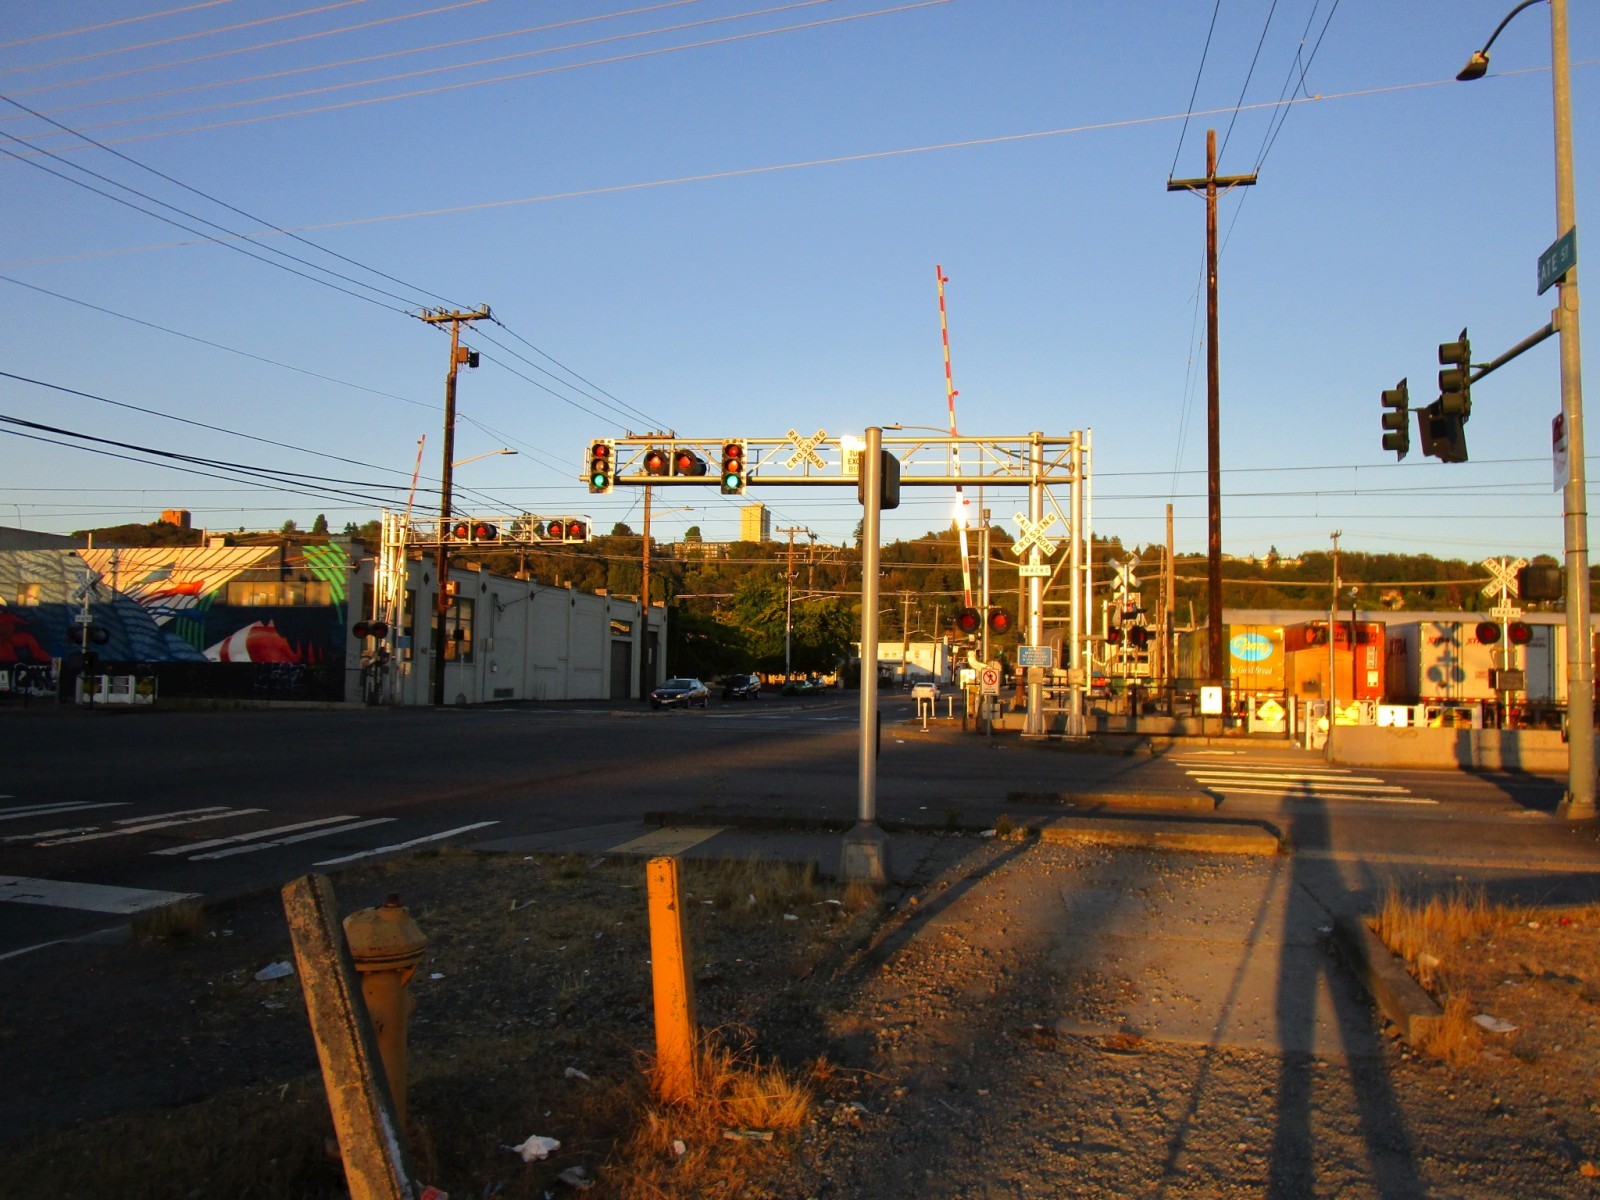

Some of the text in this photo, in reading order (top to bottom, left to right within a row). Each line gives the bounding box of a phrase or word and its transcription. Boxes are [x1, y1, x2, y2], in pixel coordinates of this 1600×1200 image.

[1541, 243, 1569, 283] ATE ST
[786, 430, 826, 468] CROSSING
[788, 430, 825, 469] RAILROAD
[1013, 514, 1056, 553] CROSSING
[1016, 514, 1054, 554] RAILROAD
[1486, 559, 1518, 589] RAILRO
